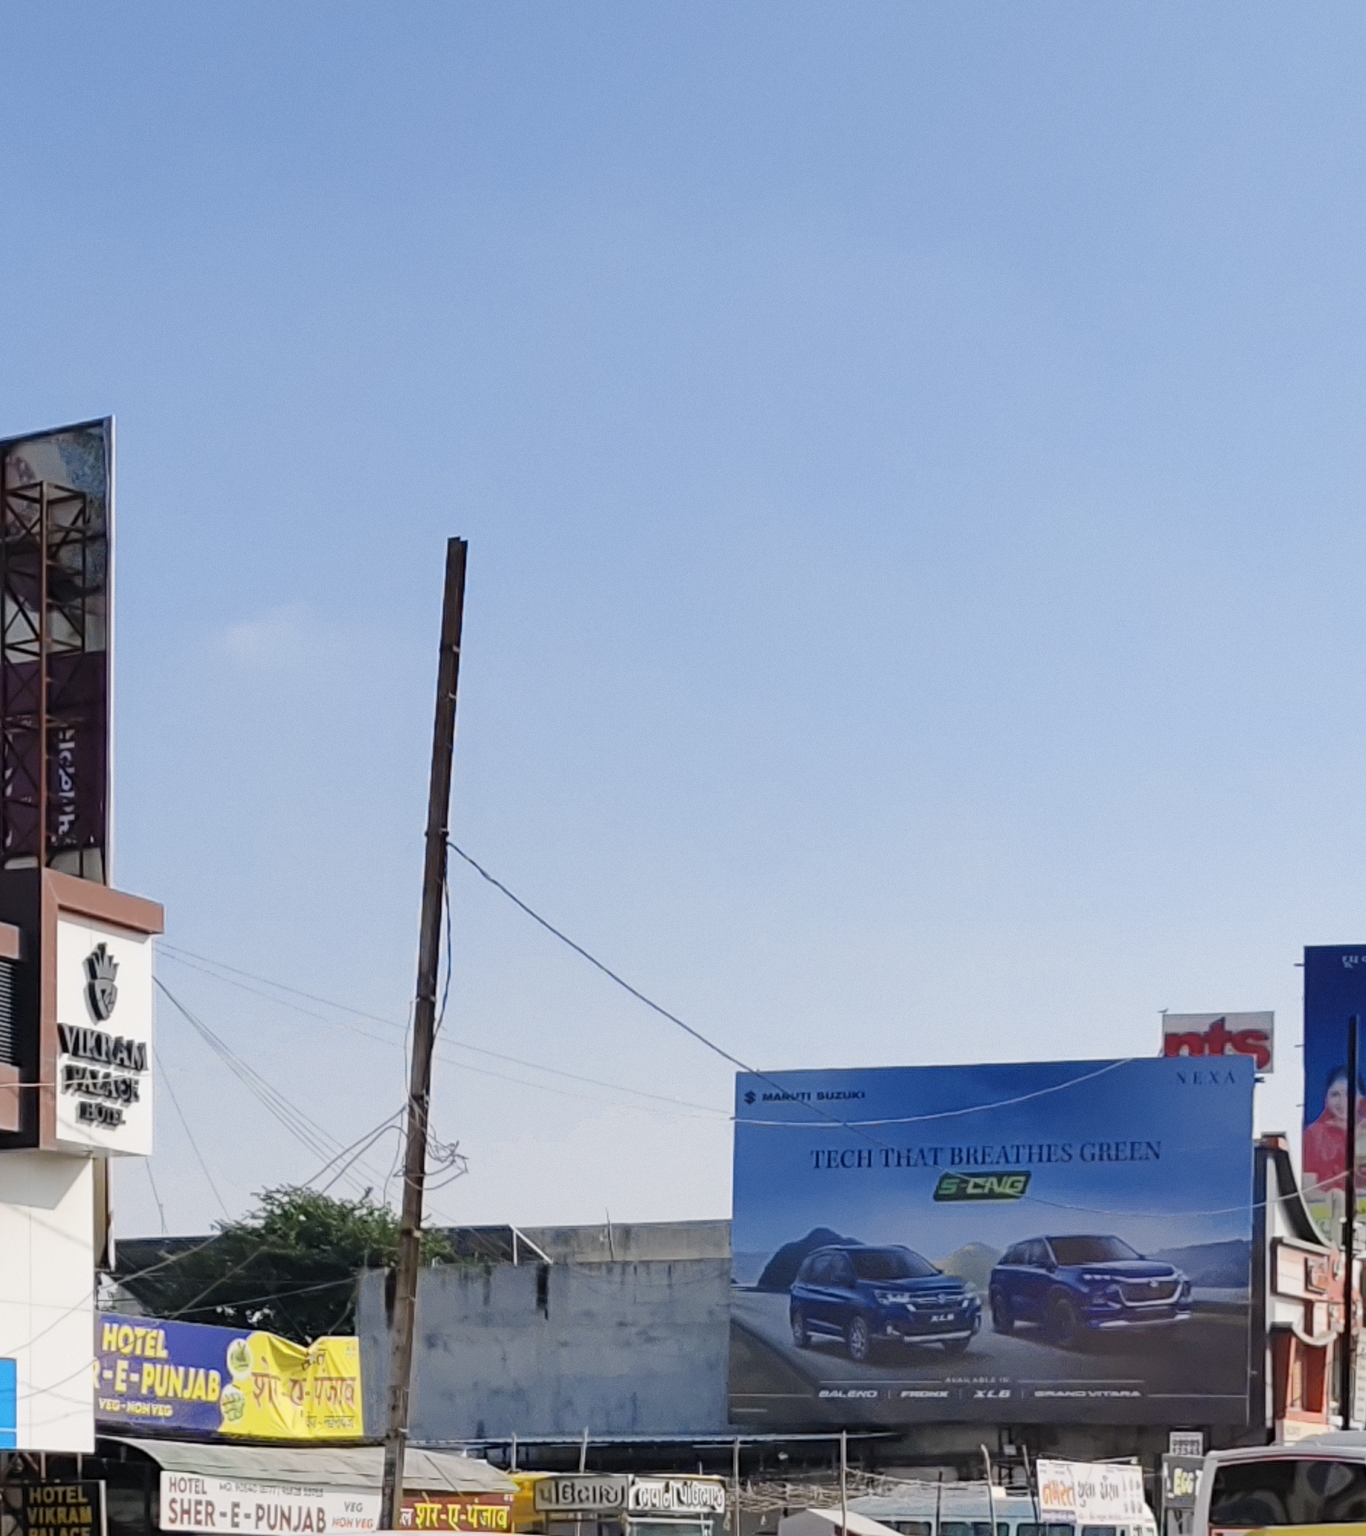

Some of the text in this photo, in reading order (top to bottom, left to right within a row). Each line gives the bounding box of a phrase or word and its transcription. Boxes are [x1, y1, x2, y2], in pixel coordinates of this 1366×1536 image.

[56, 1023, 149, 1072] VIKRAM
[61, 1065, 140, 1104] PALACE
[1176, 1071, 1236, 1085] NEXA
[762, 1090, 866, 1101] MARUTI SUZUKI
[76, 1101, 126, 1128] HOTEL
[810, 1141, 1162, 1169] TECH THAT BREATHES GREEN
[938, 1176, 1026, 1195] S-CNG
[102, 1323, 169, 1359] HOTEL
[818, 1389, 878, 1399] BALENO
[900, 1389, 949, 1399] FRONX
[973, 1389, 1011, 1399] XL6
[29, 1485, 88, 1504] HOTEL
[168, 1476, 208, 1496] HOTEL
[27, 1506, 92, 1525] VIKRAM
[343, 1501, 364, 1513] VEG
[355, 1517, 375, 1530] VEG
